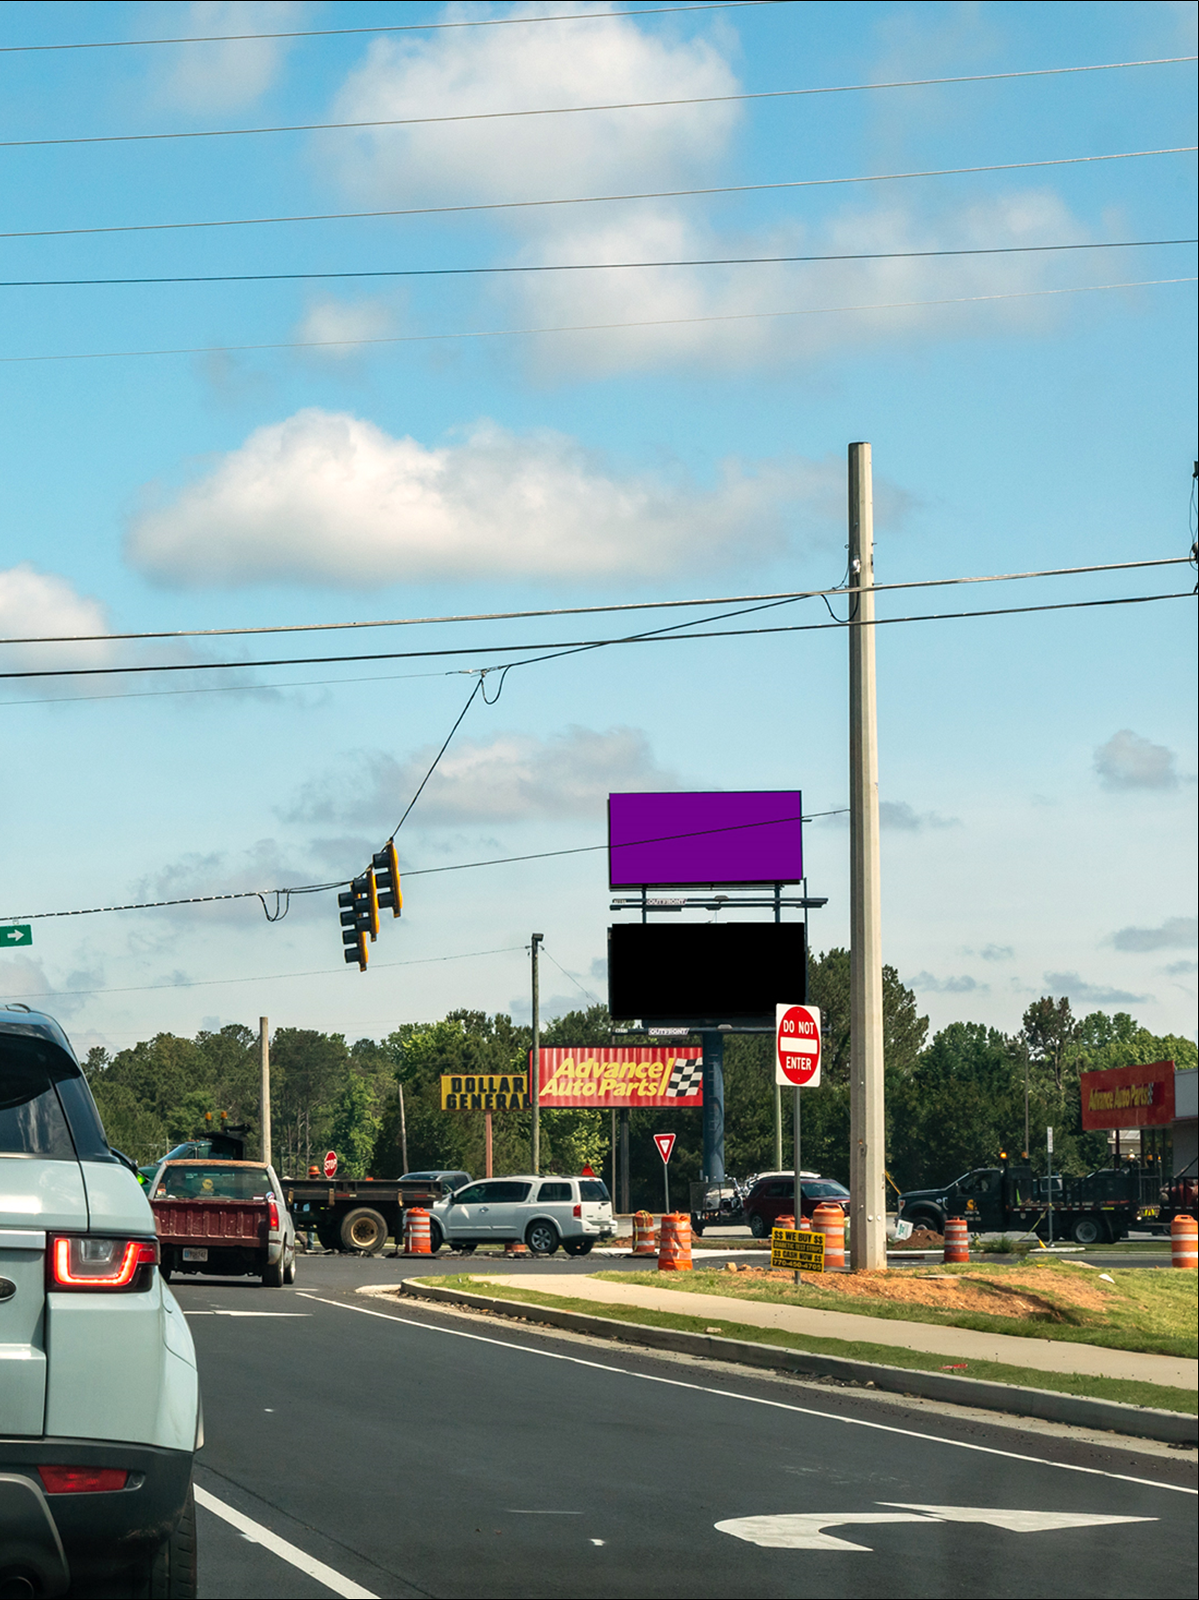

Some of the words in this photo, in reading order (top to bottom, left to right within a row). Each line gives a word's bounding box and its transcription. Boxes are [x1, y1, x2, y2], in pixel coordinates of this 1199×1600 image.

[783, 1019, 795, 1033] DO
[798, 1021, 814, 1035] NOT
[552, 1058, 664, 1079] Advance
[786, 1056, 812, 1071] ENTER
[451, 1077, 525, 1093] DOLLAR
[539, 1079, 597, 1096] Auto
[598, 1079, 659, 1096] Parts
[446, 1094, 532, 1109] GENERAL
[325, 1158, 337, 1170] STOP
[785, 1231, 797, 1241] WE
[798, 1233, 812, 1242] BUY
